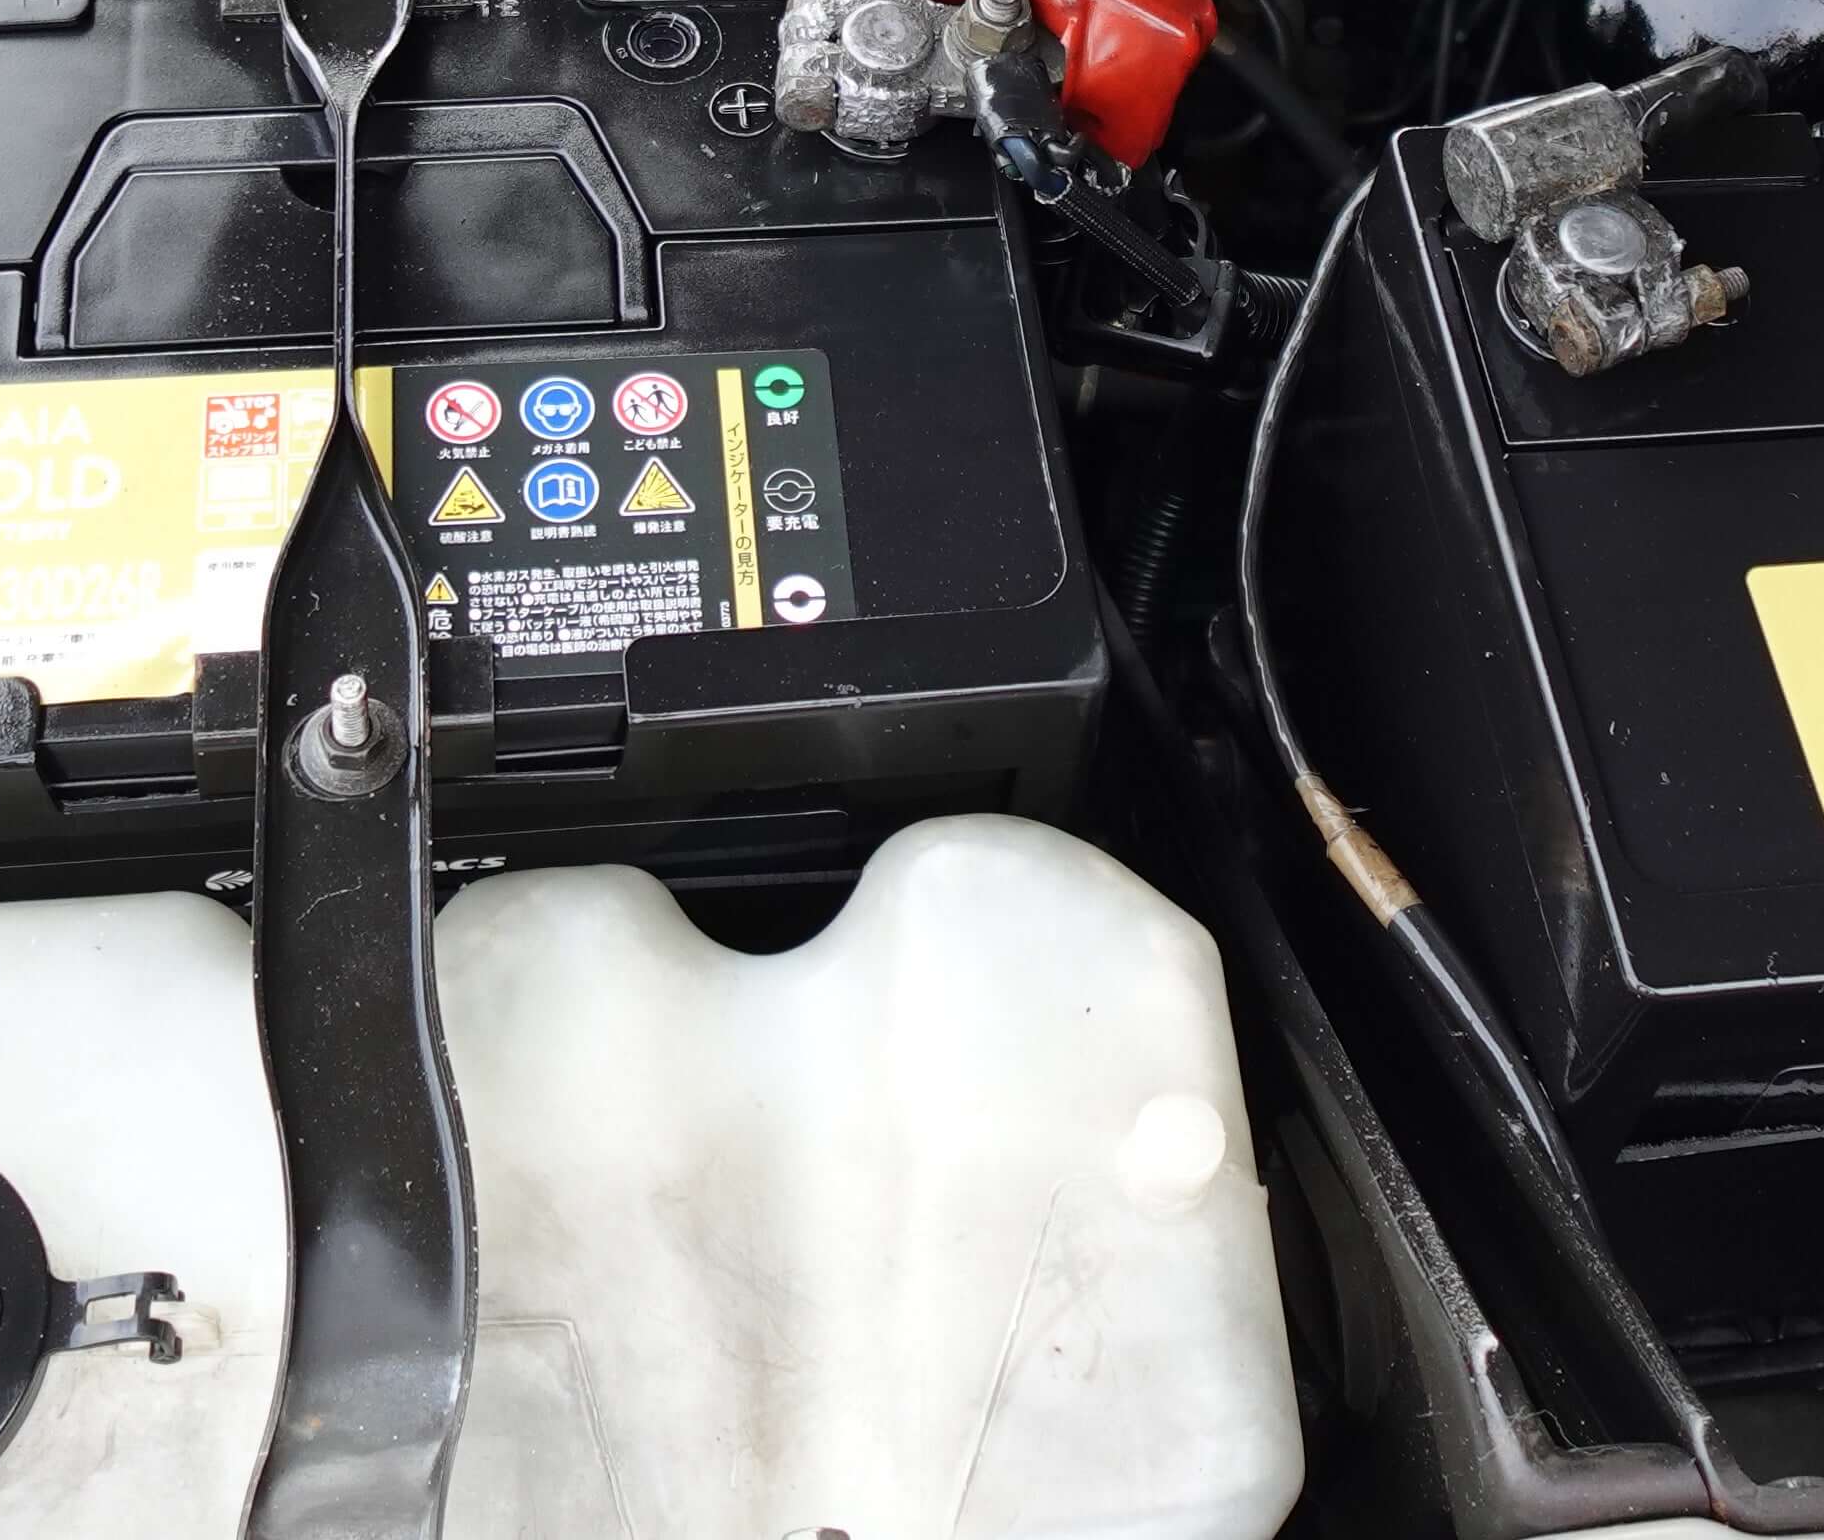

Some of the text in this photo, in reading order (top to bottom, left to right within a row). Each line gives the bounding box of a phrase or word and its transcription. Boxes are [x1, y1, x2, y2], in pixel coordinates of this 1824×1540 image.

[233, 395, 276, 412] STOP
[765, 410, 800, 427] 良好
[207, 430, 278, 445] アイドリング
[623, 437, 683, 452] こども禁止
[725, 422, 756, 588] インジケーターの見方
[765, 514, 821, 533] 要充電
